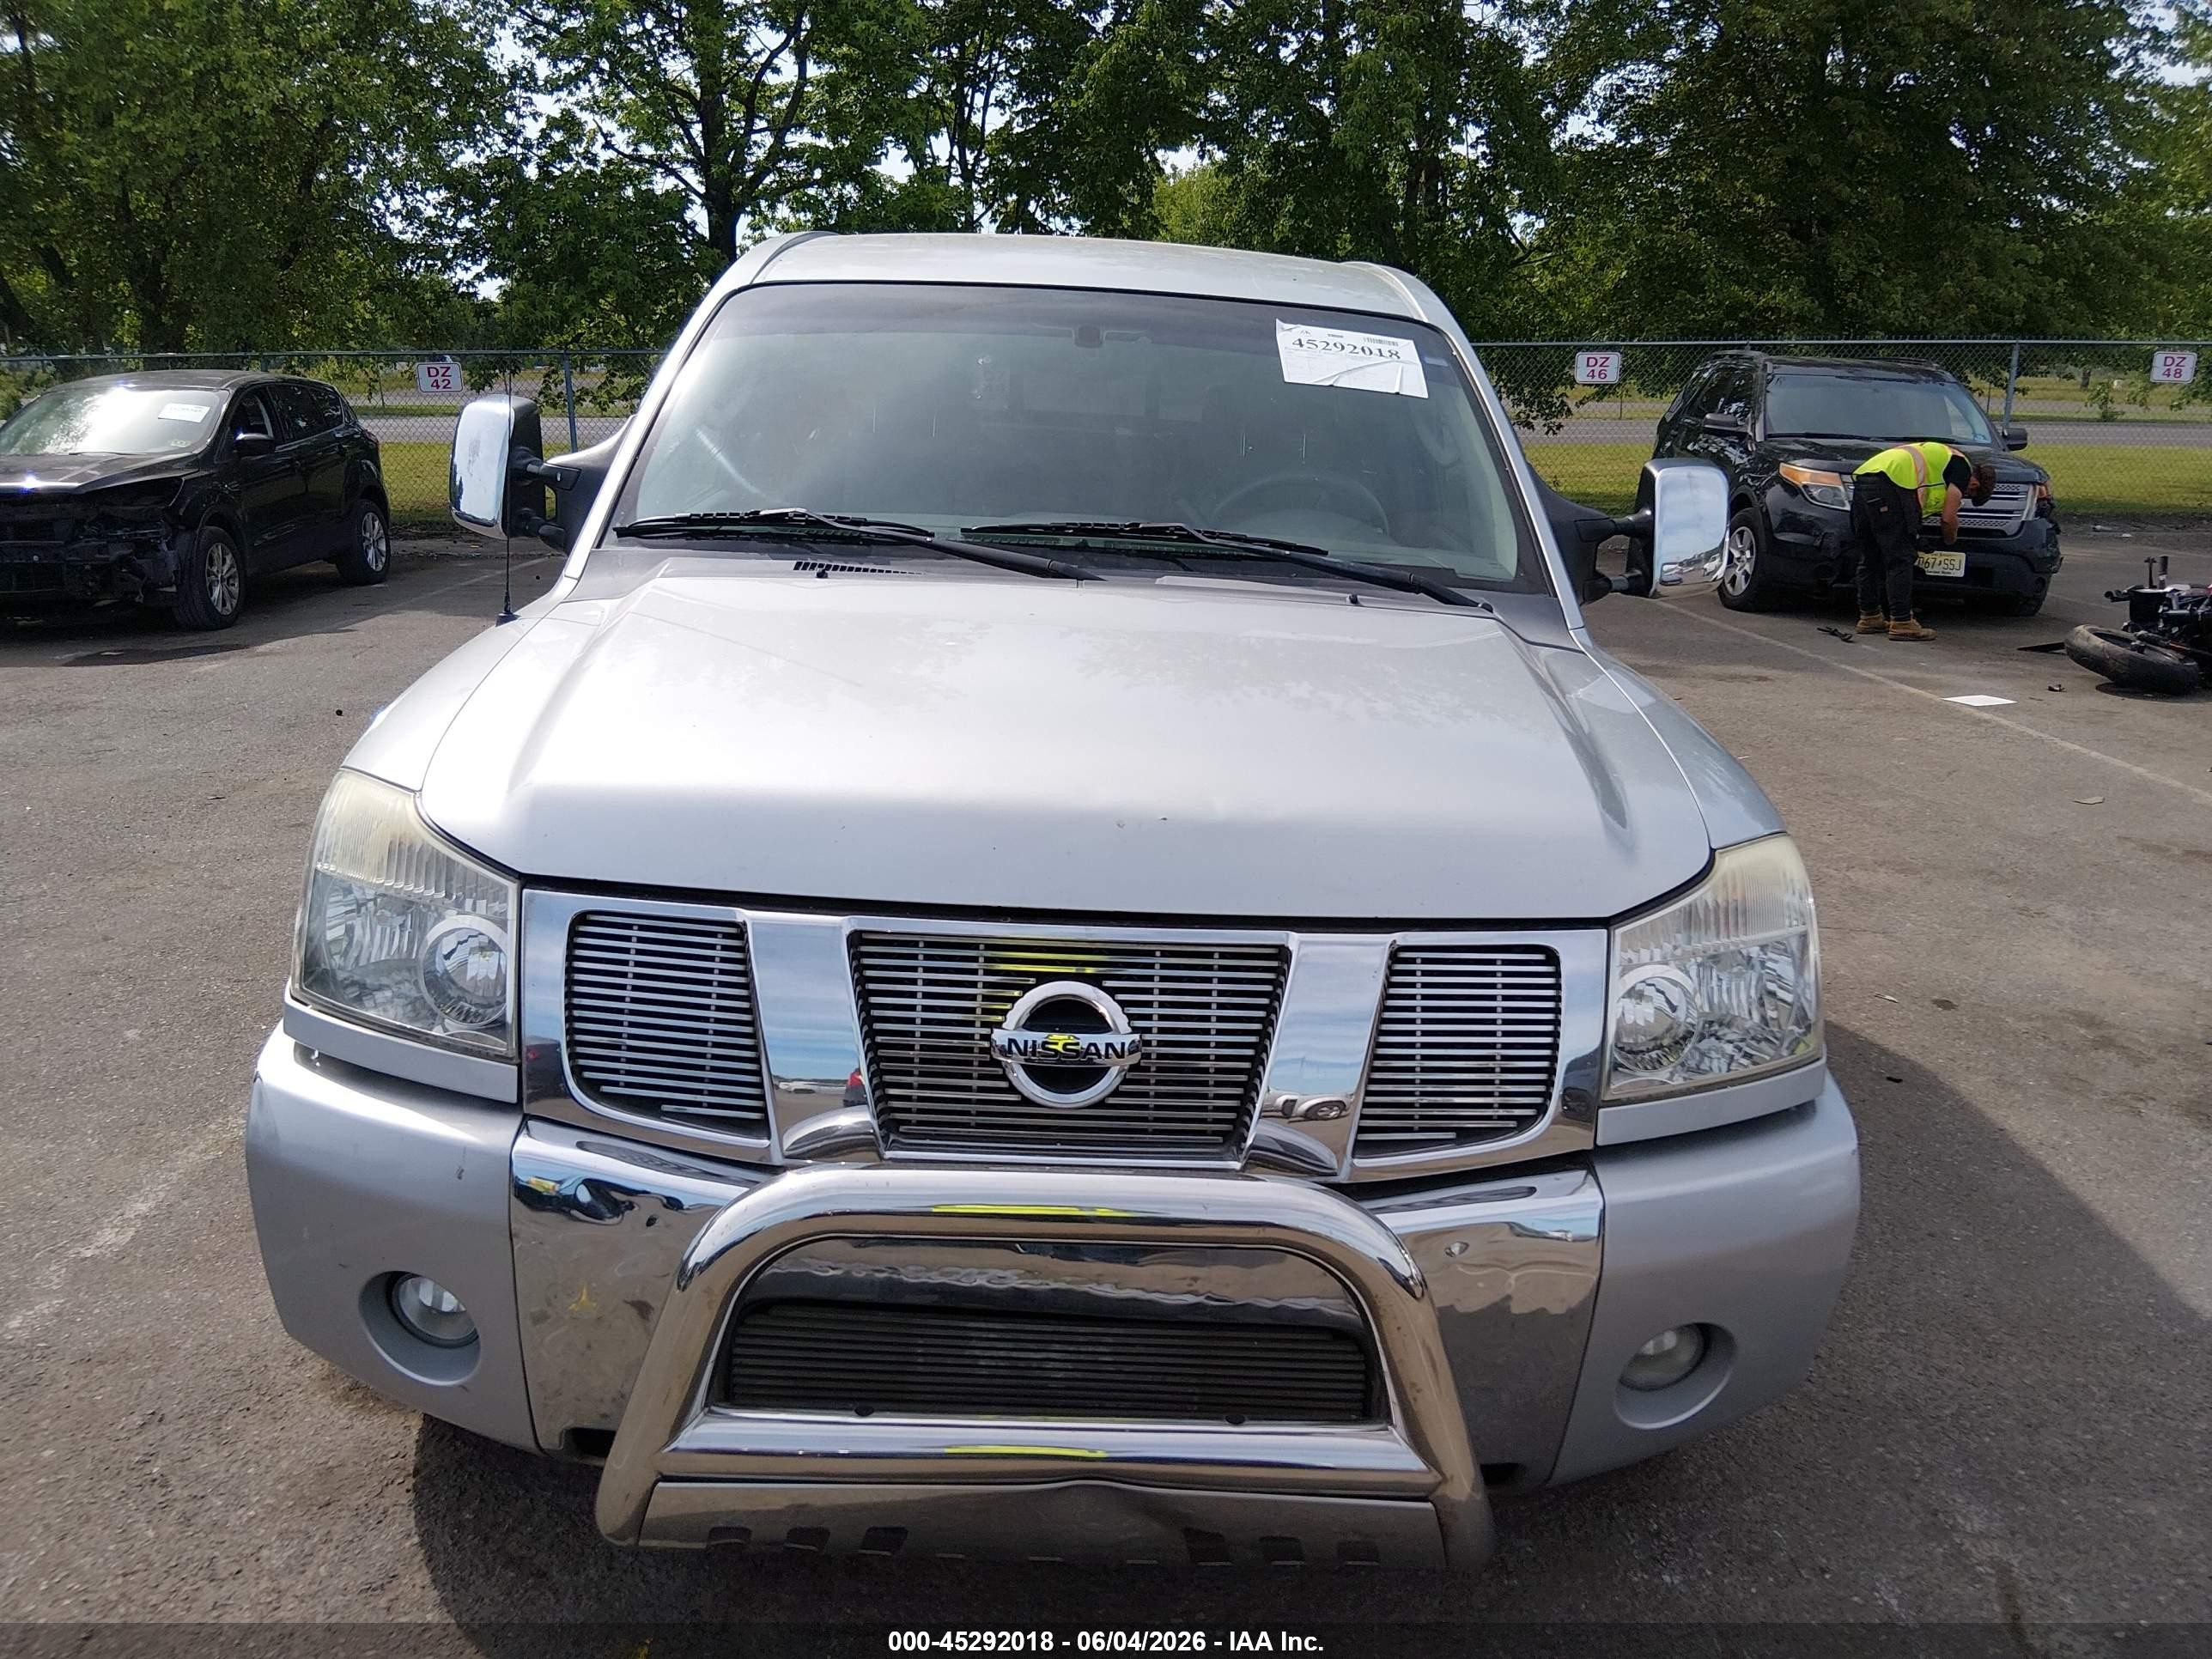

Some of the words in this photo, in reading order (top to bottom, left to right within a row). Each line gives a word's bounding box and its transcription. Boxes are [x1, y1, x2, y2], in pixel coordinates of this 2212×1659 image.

[1291, 337, 1401, 360] 45292018
[1586, 356, 1610, 368] DZ
[2163, 356, 2186, 367] DZ
[427, 366, 453, 378] DZ
[1586, 369, 1607, 380] 46
[2162, 368, 2183, 379] 48
[430, 379, 453, 390] 42
[1007, 1037, 1126, 1060] NISSAN
